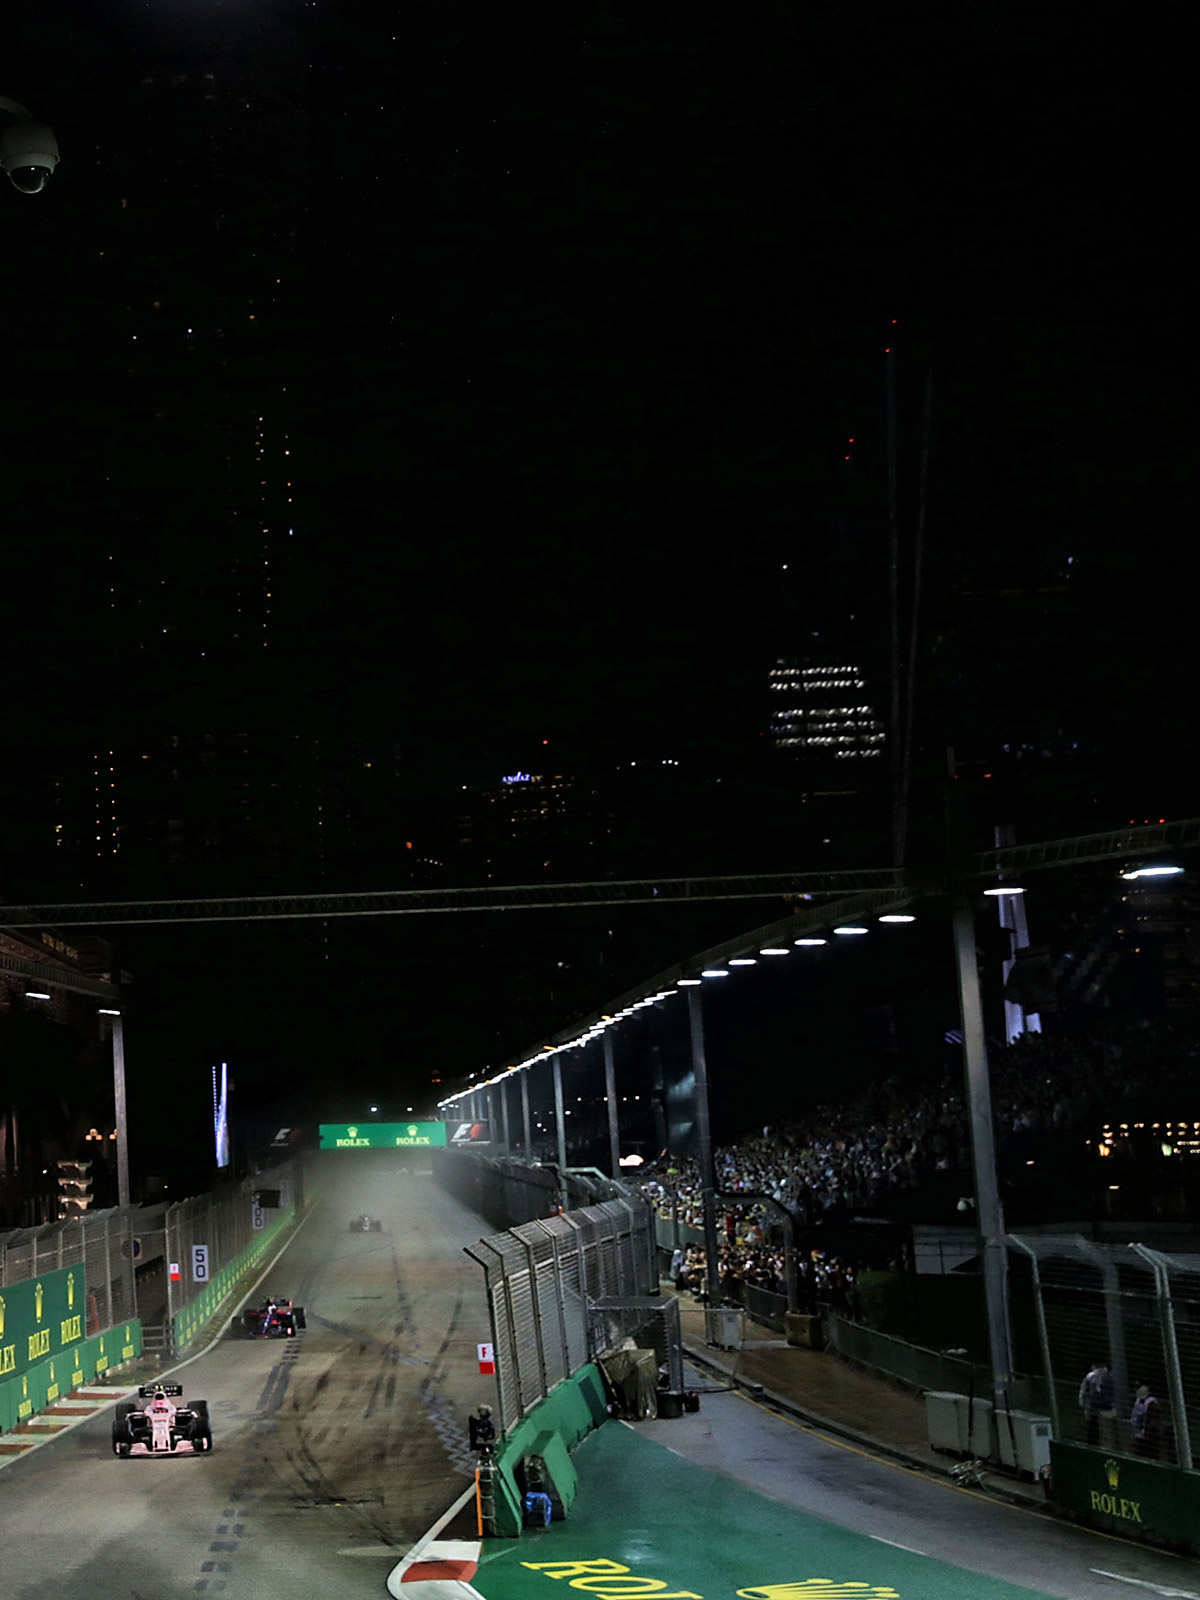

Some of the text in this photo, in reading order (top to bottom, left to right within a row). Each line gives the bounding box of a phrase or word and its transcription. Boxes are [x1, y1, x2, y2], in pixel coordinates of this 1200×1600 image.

[336, 1138, 370, 1147] ROLEX
[396, 1137, 430, 1146] ROLEX
[28, 1328, 50, 1361] ROLEX
[1091, 1490, 1143, 1523] ROLEX
